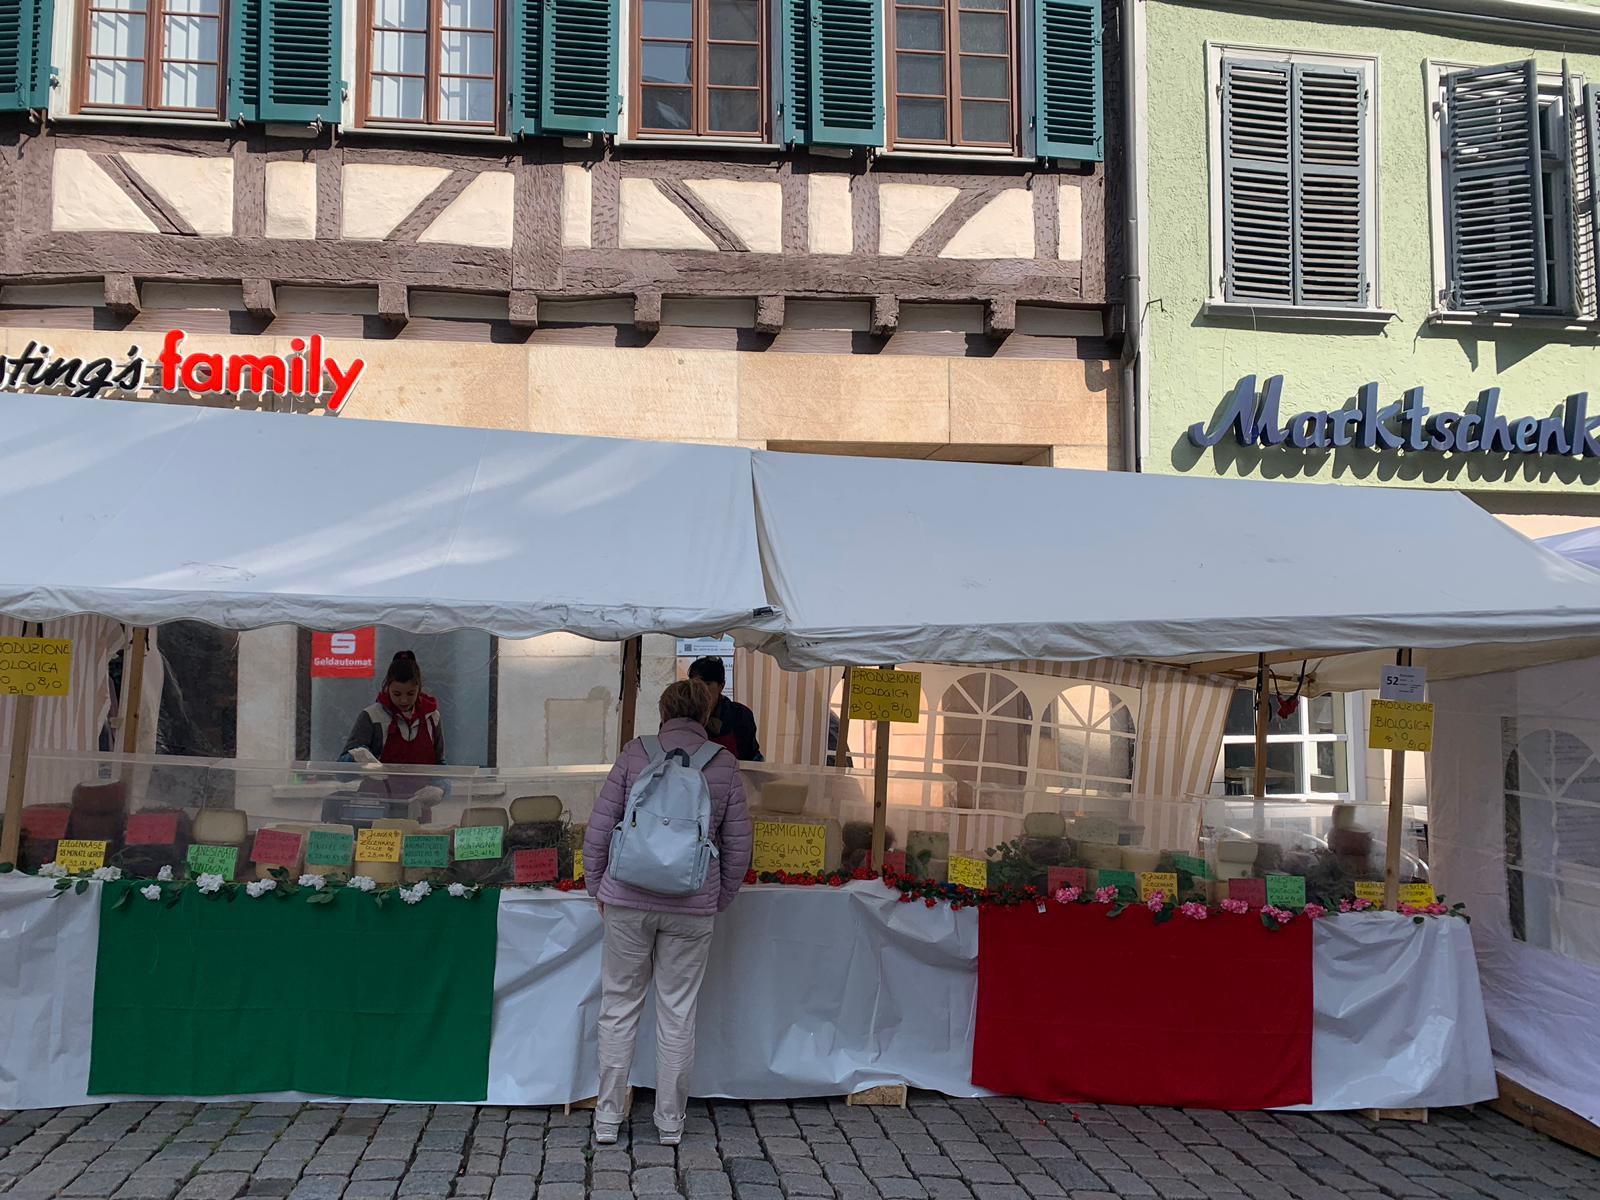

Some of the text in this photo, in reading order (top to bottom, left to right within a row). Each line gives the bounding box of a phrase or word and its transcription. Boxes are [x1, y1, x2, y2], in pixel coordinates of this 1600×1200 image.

[160, 330, 366, 411] family
[0, 642, 70, 655] ODUZIONE
[314, 657, 372, 667] Geldautomat
[852, 670, 920, 684] PRODUZIONE
[1387, 676, 1399, 686] 52
[1372, 701, 1434, 713] PRODUZIONE
[1375, 716, 1430, 731] BIOLOGICA
[756, 823, 825, 839] PARMIGIANO
[755, 840, 821, 857] REGGIANO
